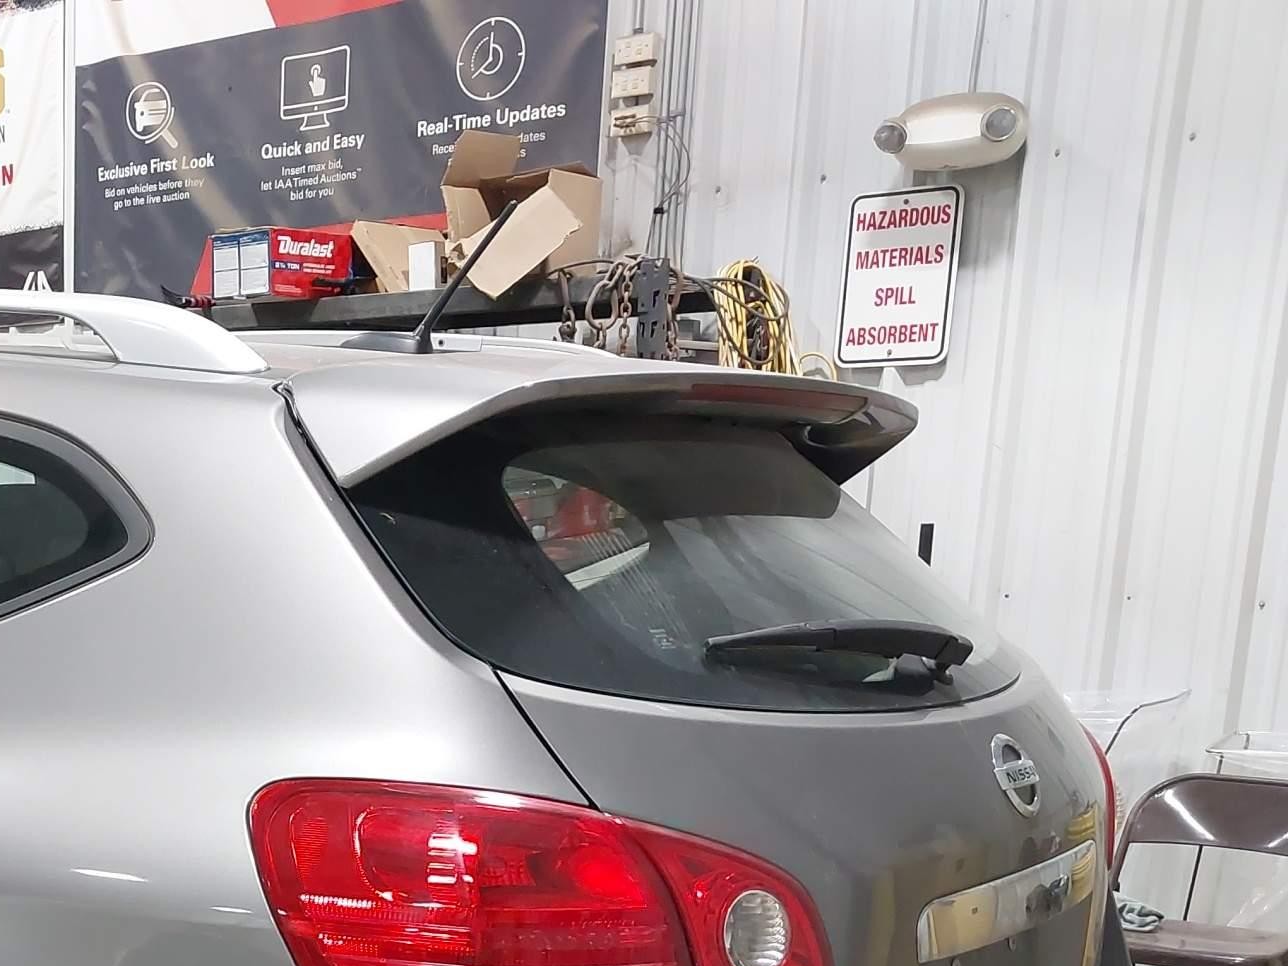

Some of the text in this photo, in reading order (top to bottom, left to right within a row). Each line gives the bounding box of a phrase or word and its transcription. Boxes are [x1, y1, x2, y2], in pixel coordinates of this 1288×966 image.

[417, 103, 566, 138] Real-Time Updates
[261, 133, 365, 159] Quick and Easy
[432, 144, 456, 155] Rece
[97, 152, 214, 182] Exclusive First Look
[281, 158, 343, 176] Insert max bid,
[104, 178, 205, 198] Bid on vehicles before they
[261, 181, 272, 191] let
[274, 179, 292, 189] IAA
[292, 173, 319, 188] Timed
[113, 190, 190, 210] go to the live auction
[290, 188, 334, 201] bid for you
[856, 204, 952, 232] HAZARDOUS
[277, 235, 335, 258] Duralast
[855, 244, 944, 270] MATERIALS
[874, 286, 916, 307] SPILL
[845, 323, 939, 346] ABSORBENT
